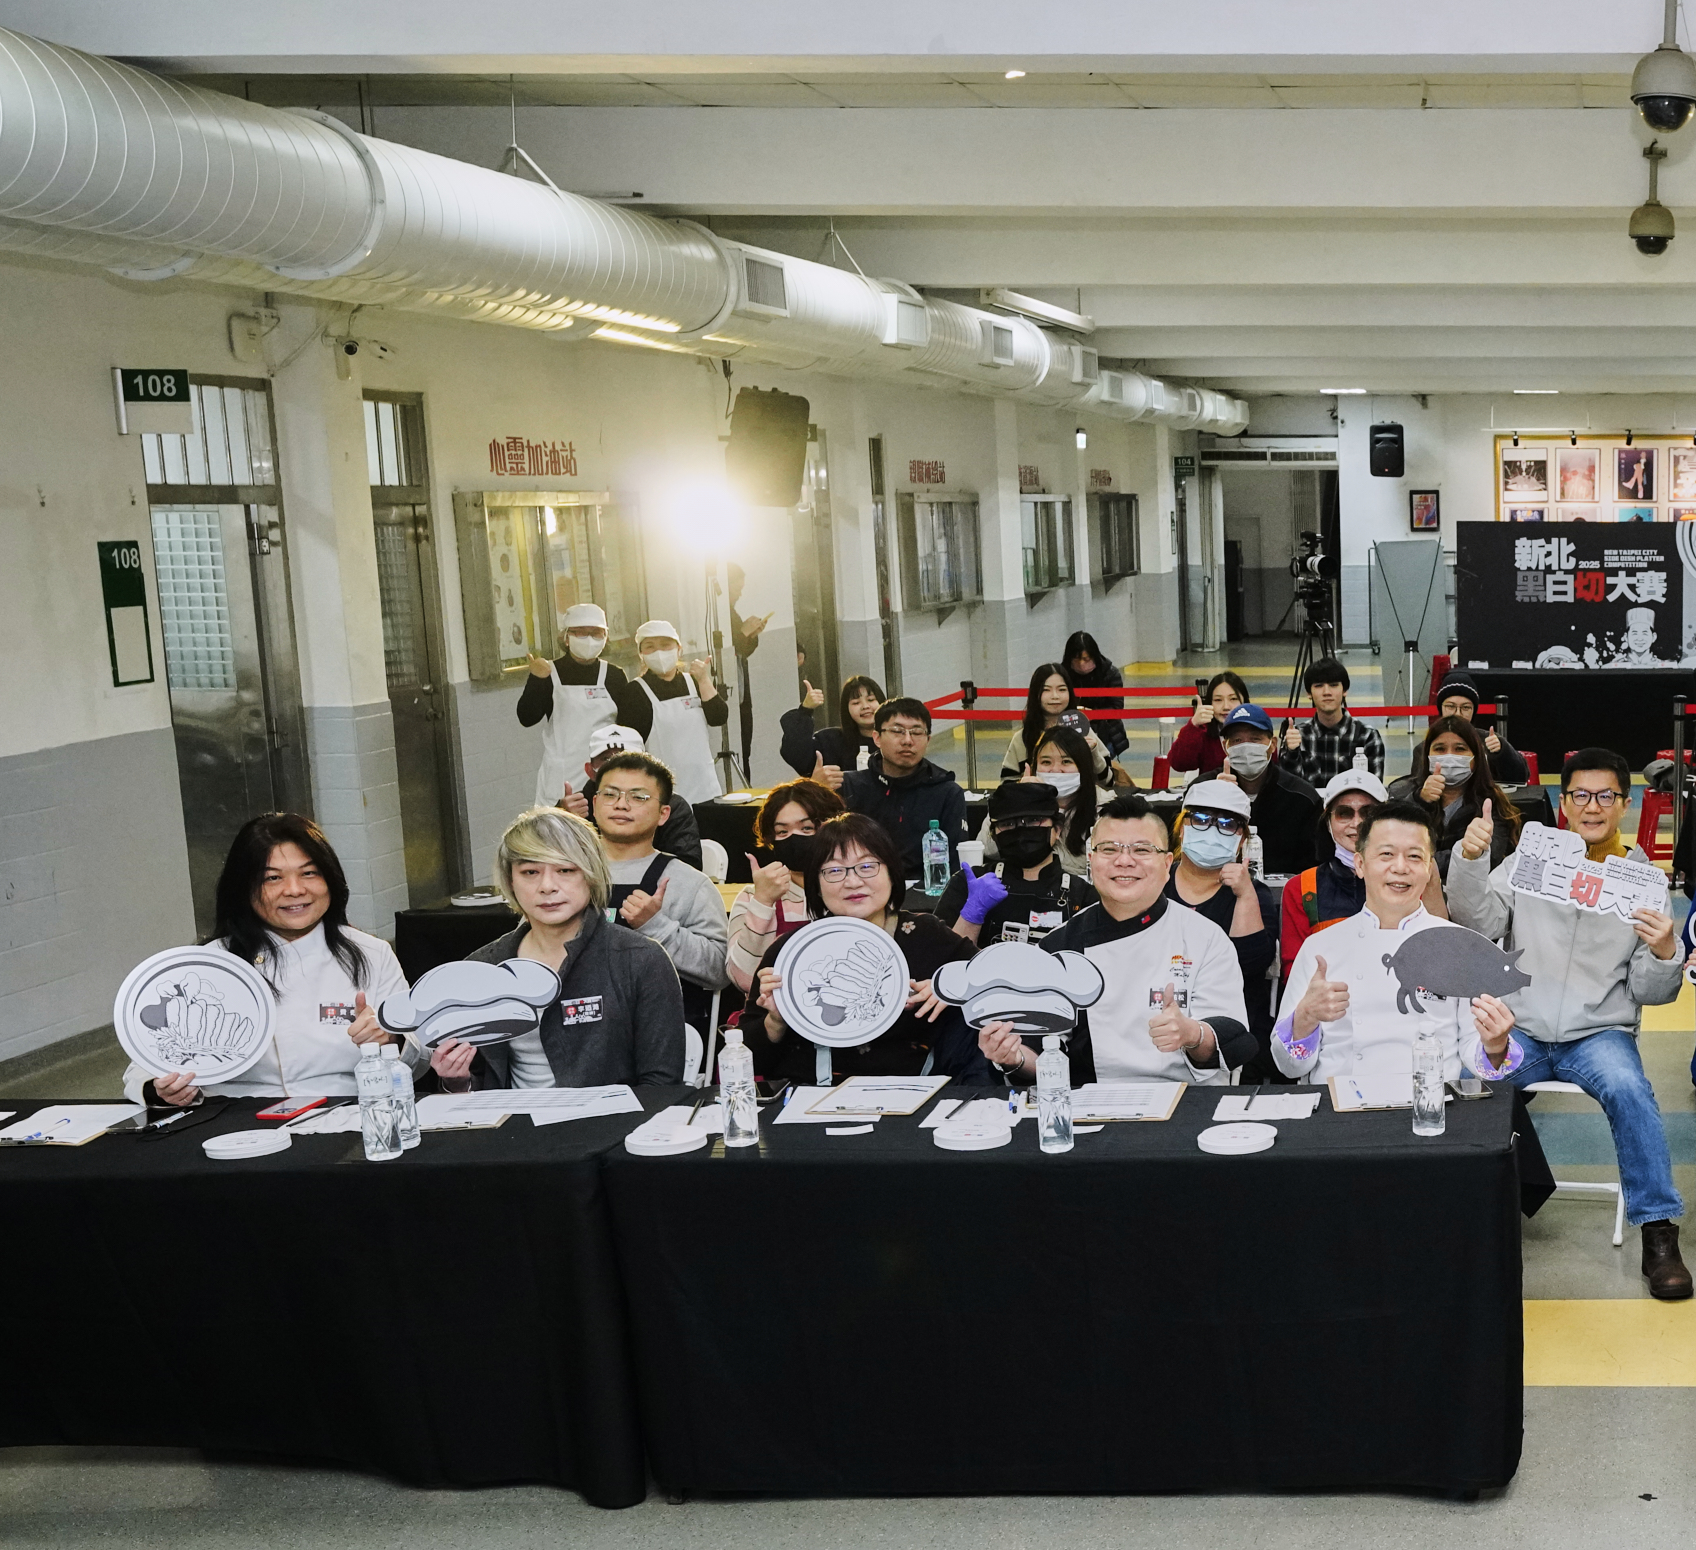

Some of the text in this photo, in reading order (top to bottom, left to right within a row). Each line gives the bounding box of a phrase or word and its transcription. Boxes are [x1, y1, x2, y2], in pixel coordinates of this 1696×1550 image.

[133, 374, 177, 397] 108
[488, 436, 578, 476] 心靈加油站
[111, 547, 140, 569] 108
[1514, 537, 1577, 571] 新北
[1578, 561, 1600, 569] 2025
[1515, 570, 1667, 604] 黑白切大賽
[1580, 862, 1603, 876] 2025
